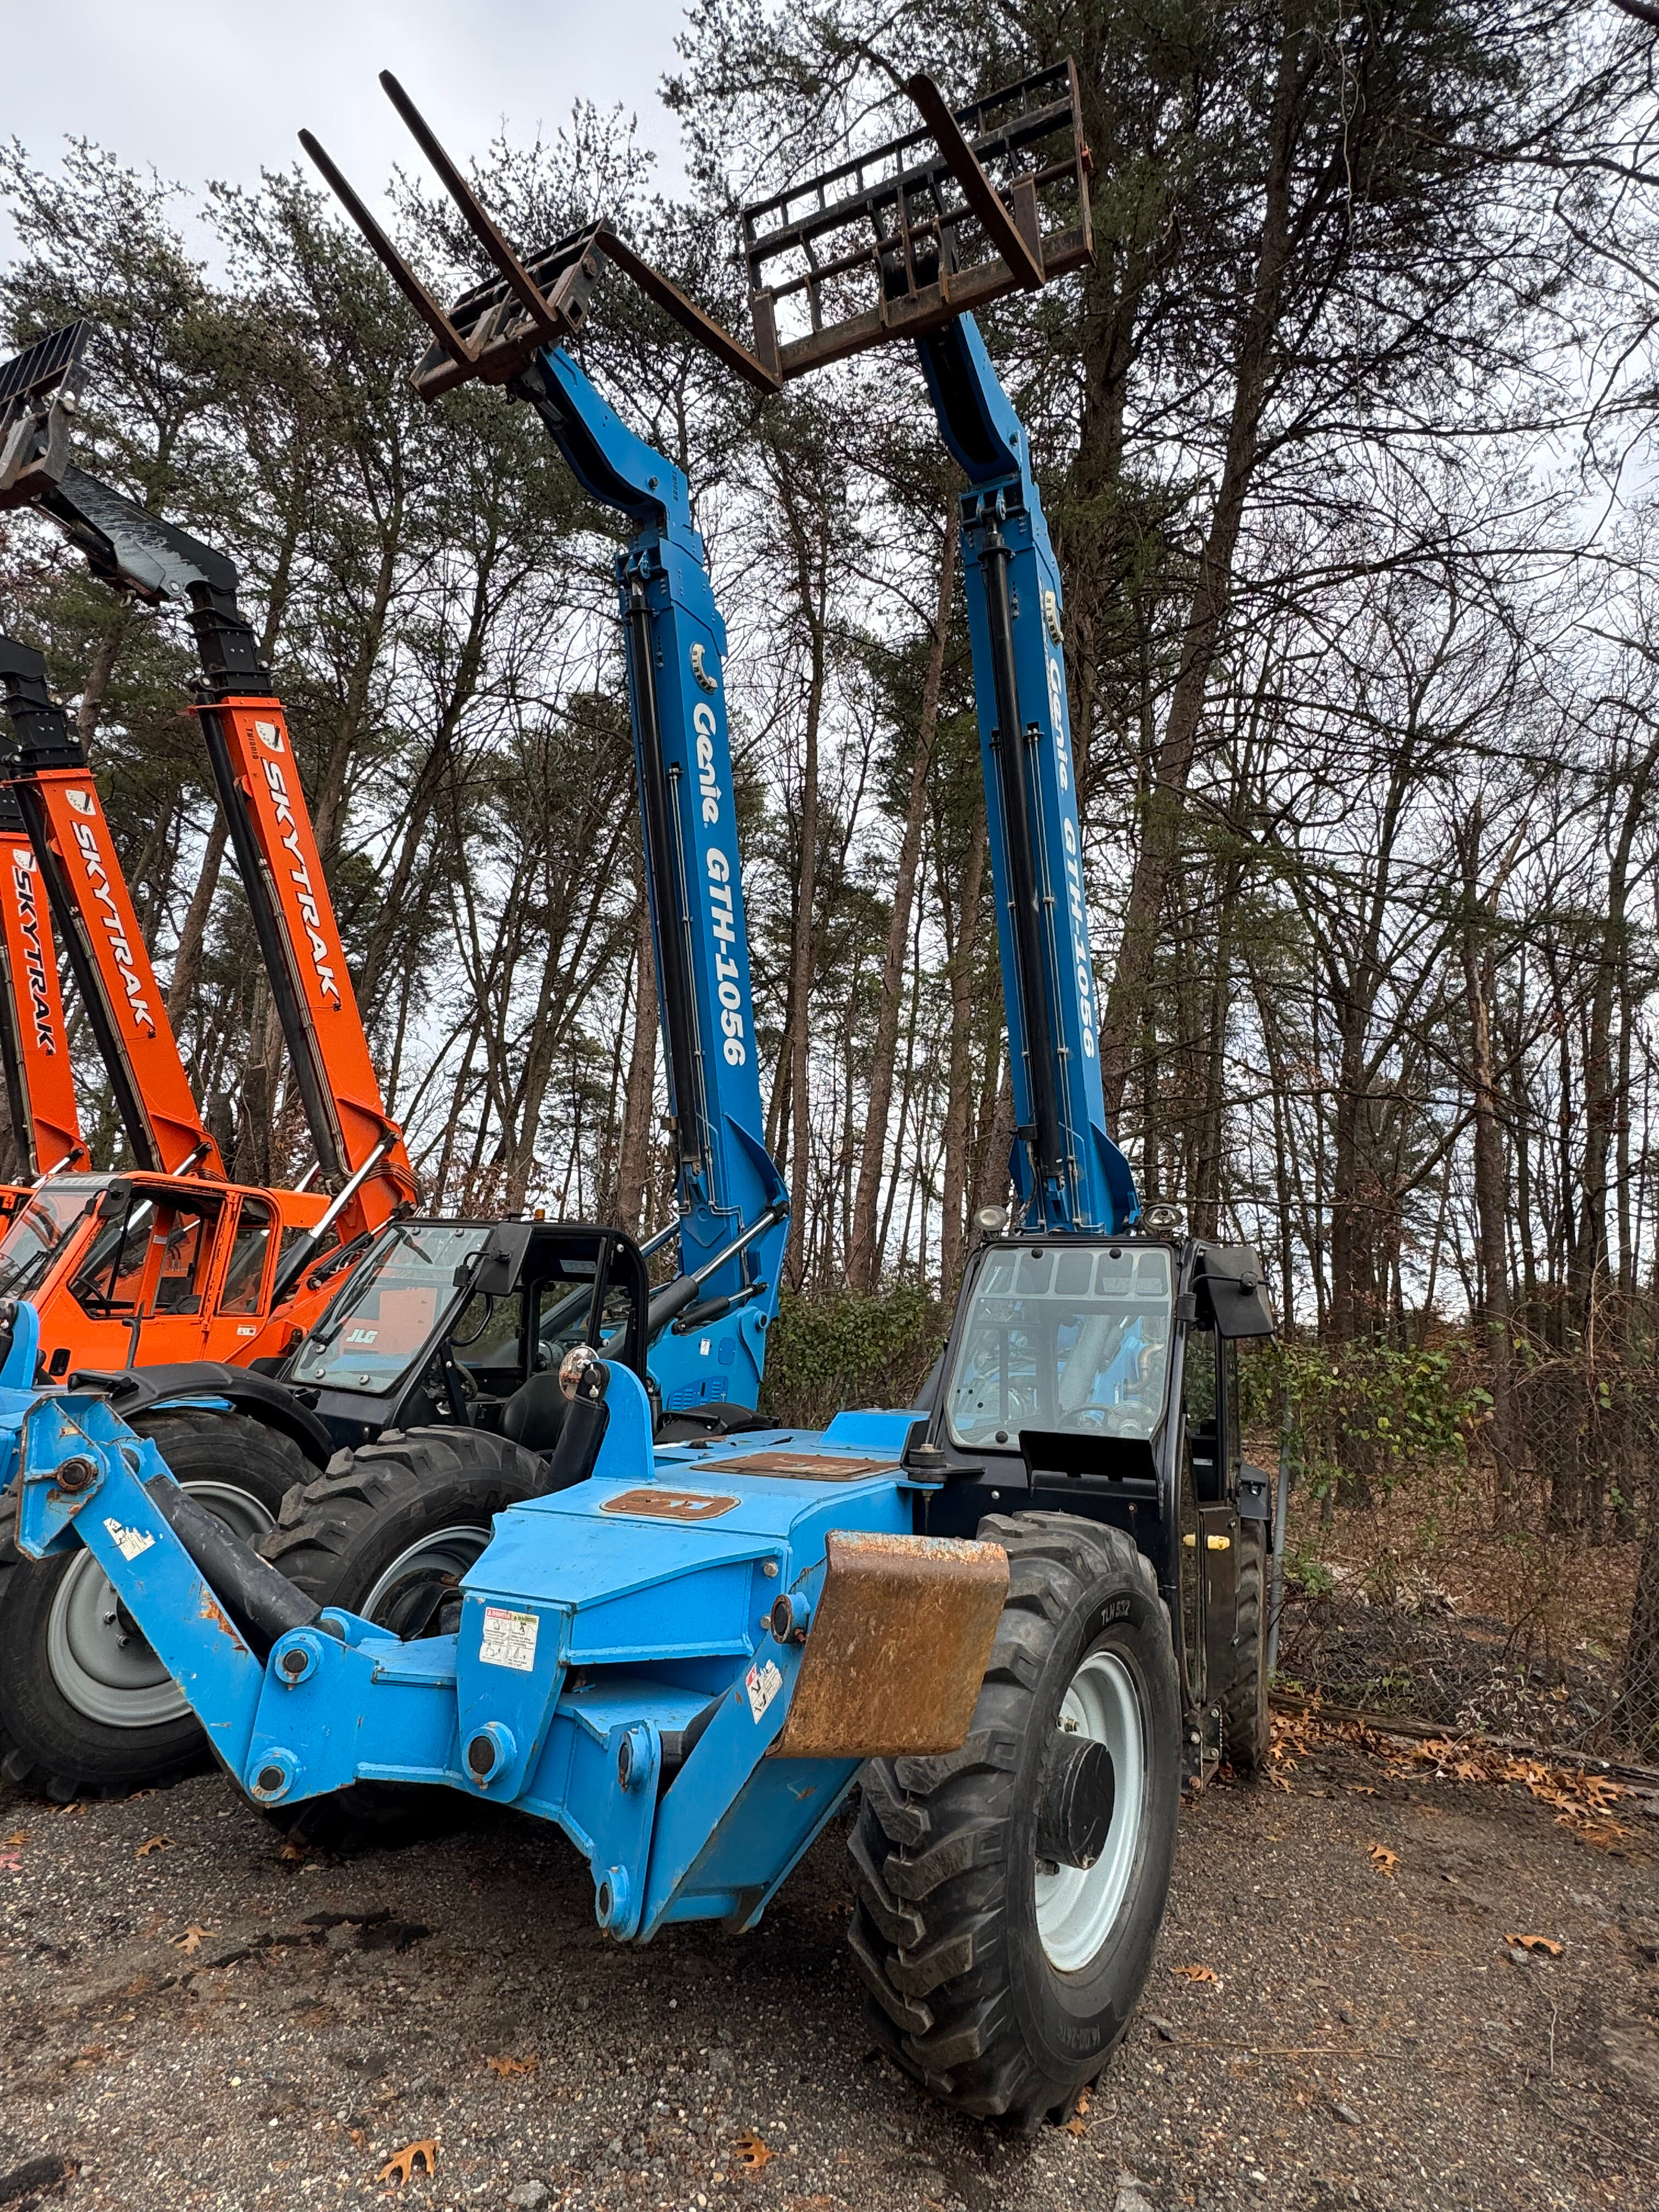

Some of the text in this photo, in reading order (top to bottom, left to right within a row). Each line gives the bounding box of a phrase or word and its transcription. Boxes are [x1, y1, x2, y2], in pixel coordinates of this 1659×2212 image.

[12, 865, 57, 1054] SKYTRAK
[70, 820, 156, 1031] SKYTRAK
[261, 757, 341, 1004] SKYTRAK
[706, 848, 746, 1066] GTH-1056
[1064, 817, 1095, 1058] GTH-1056
[346, 1329, 379, 1344] JLG
